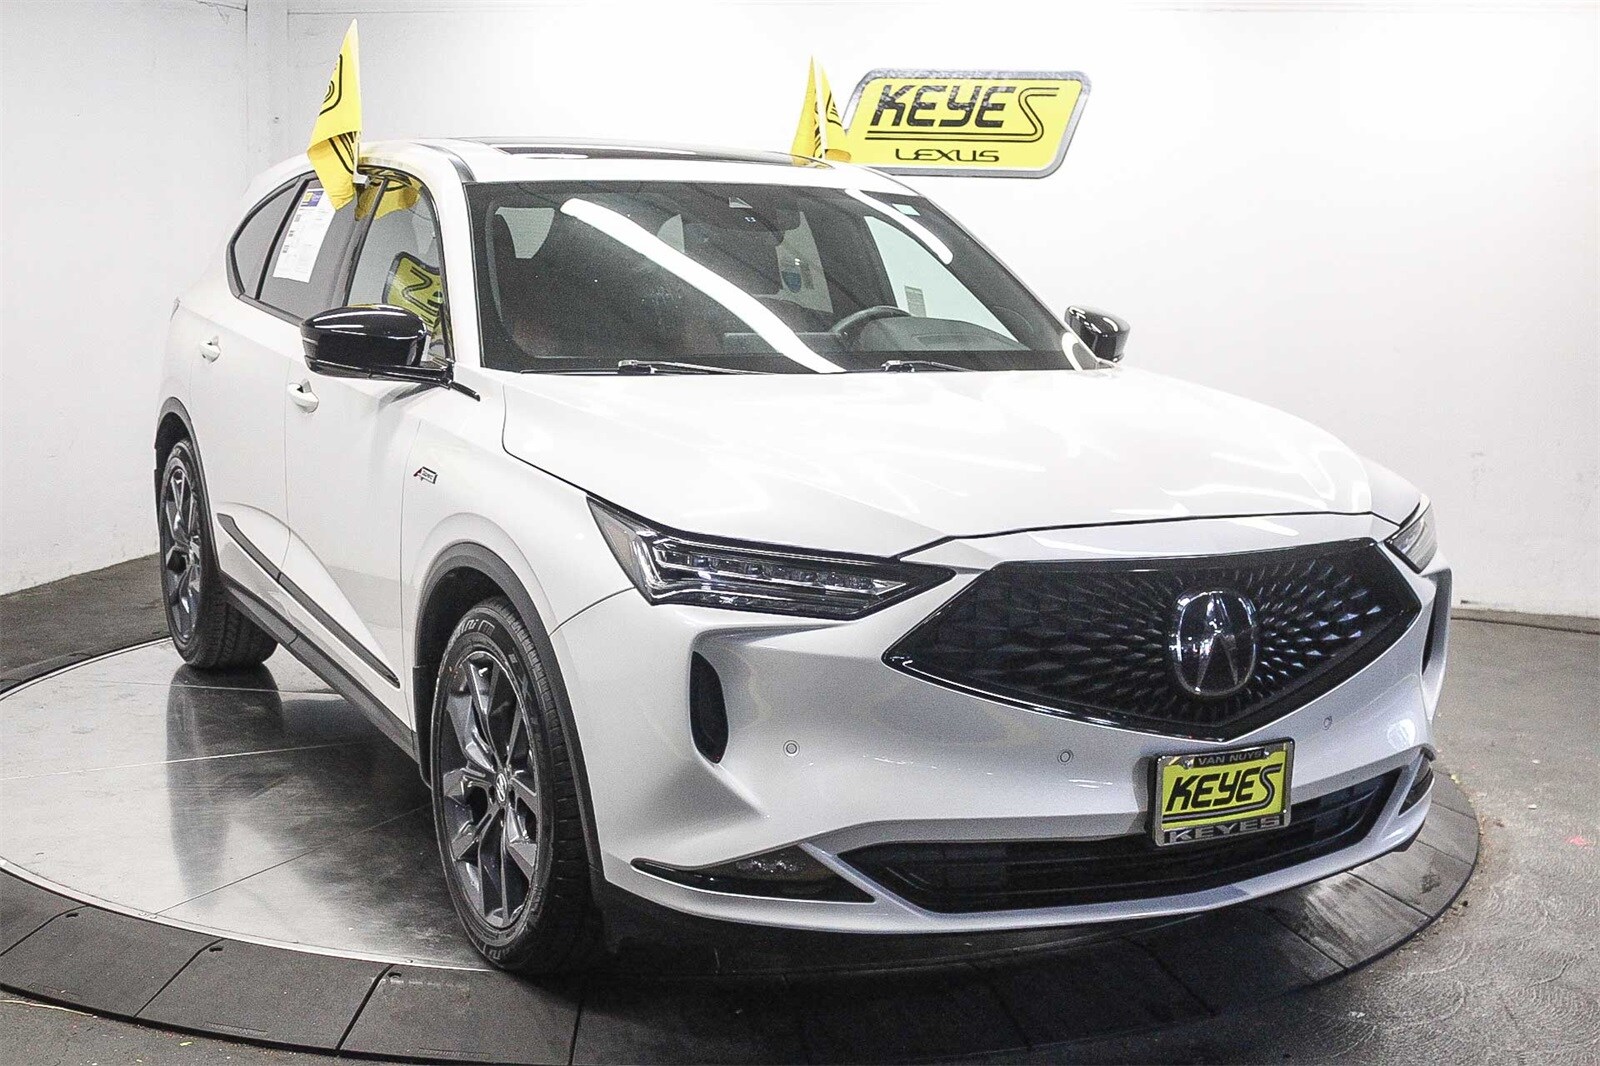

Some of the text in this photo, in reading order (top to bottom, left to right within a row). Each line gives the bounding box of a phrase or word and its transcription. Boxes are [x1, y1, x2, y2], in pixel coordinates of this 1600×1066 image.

[867, 84, 1060, 140] KEYES
[895, 148, 1000, 162] LEXUS
[1198, 751, 1262, 766] VAN NUYS
[1164, 763, 1283, 816] KEYES
[1169, 815, 1280, 843] KEYES
